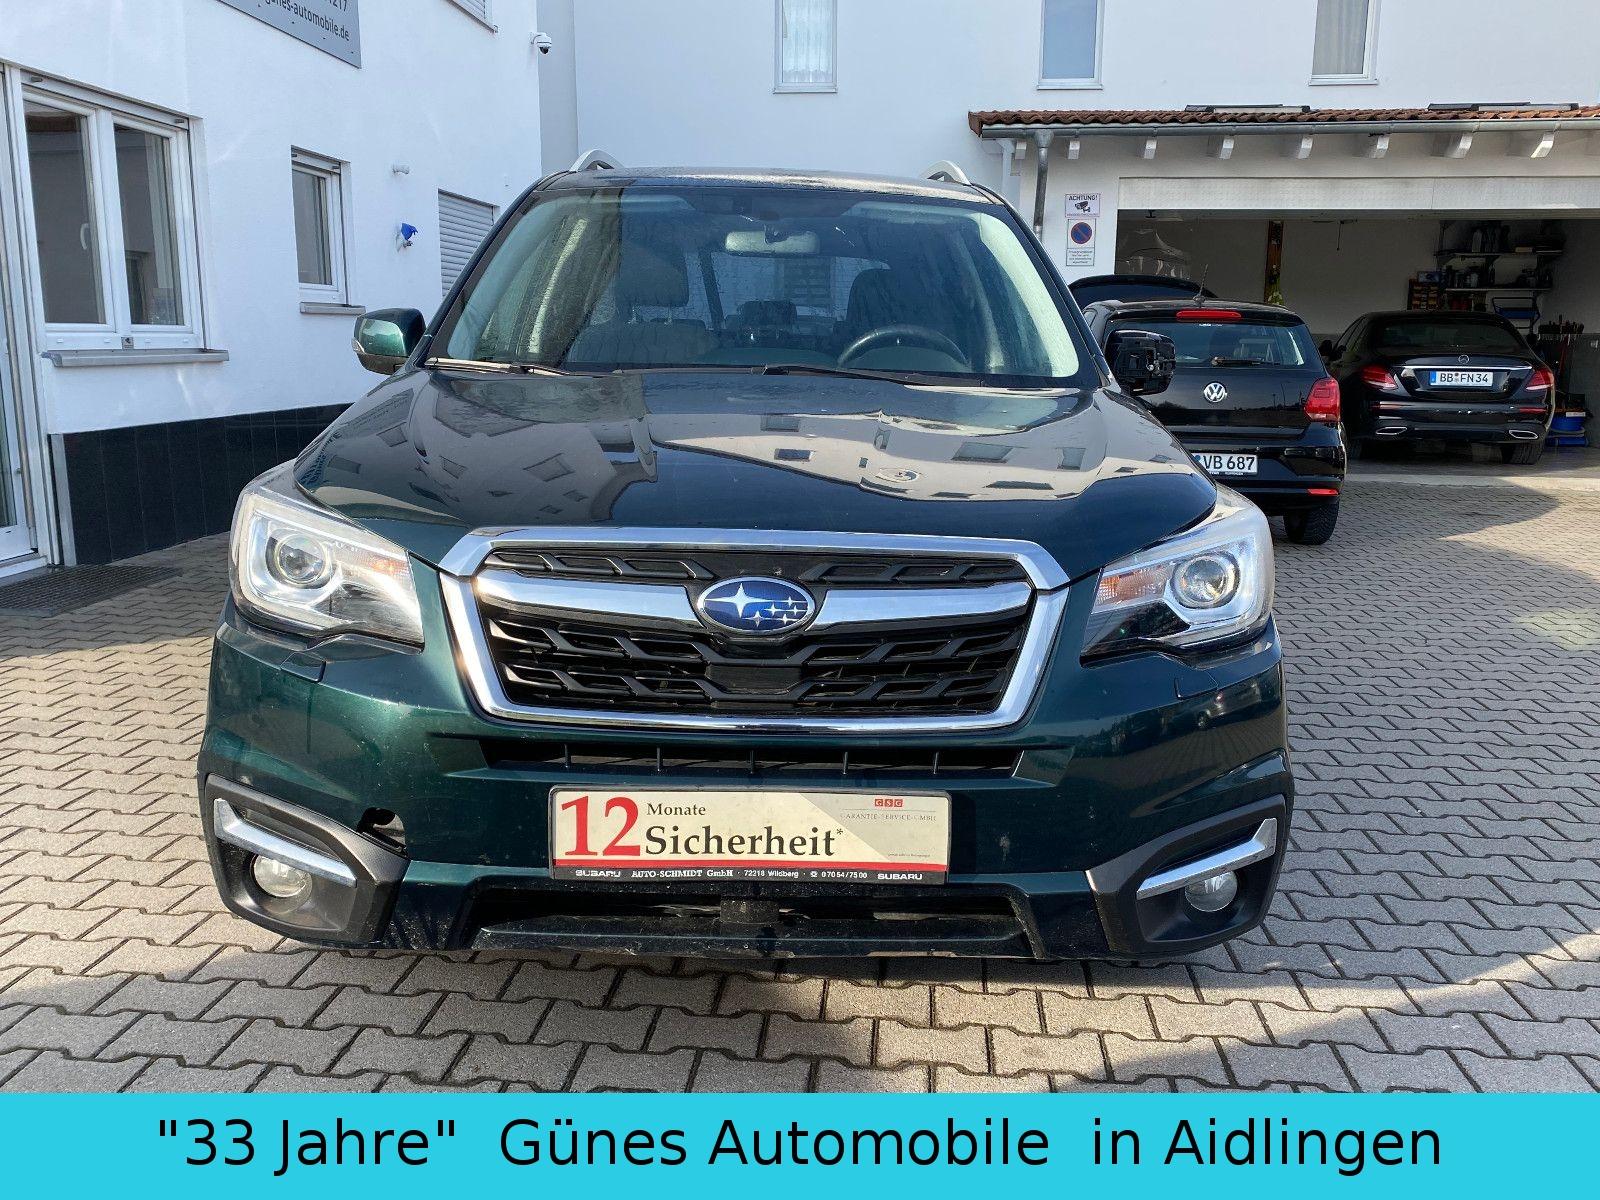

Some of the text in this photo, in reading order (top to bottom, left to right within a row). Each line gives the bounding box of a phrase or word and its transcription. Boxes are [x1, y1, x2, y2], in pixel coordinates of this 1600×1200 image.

[1440, 373, 1488, 383] BB FN 34
[1227, 456, 1255, 470] 687
[874, 799, 903, 807] GSG
[646, 803, 706, 816] Monate
[561, 795, 641, 857] 12
[575, 870, 621, 878] SUBARU
[631, 870, 703, 878] AUTO-SCHMIDT
[707, 869, 733, 877] GmbH
[767, 870, 799, 879] Wildberg
